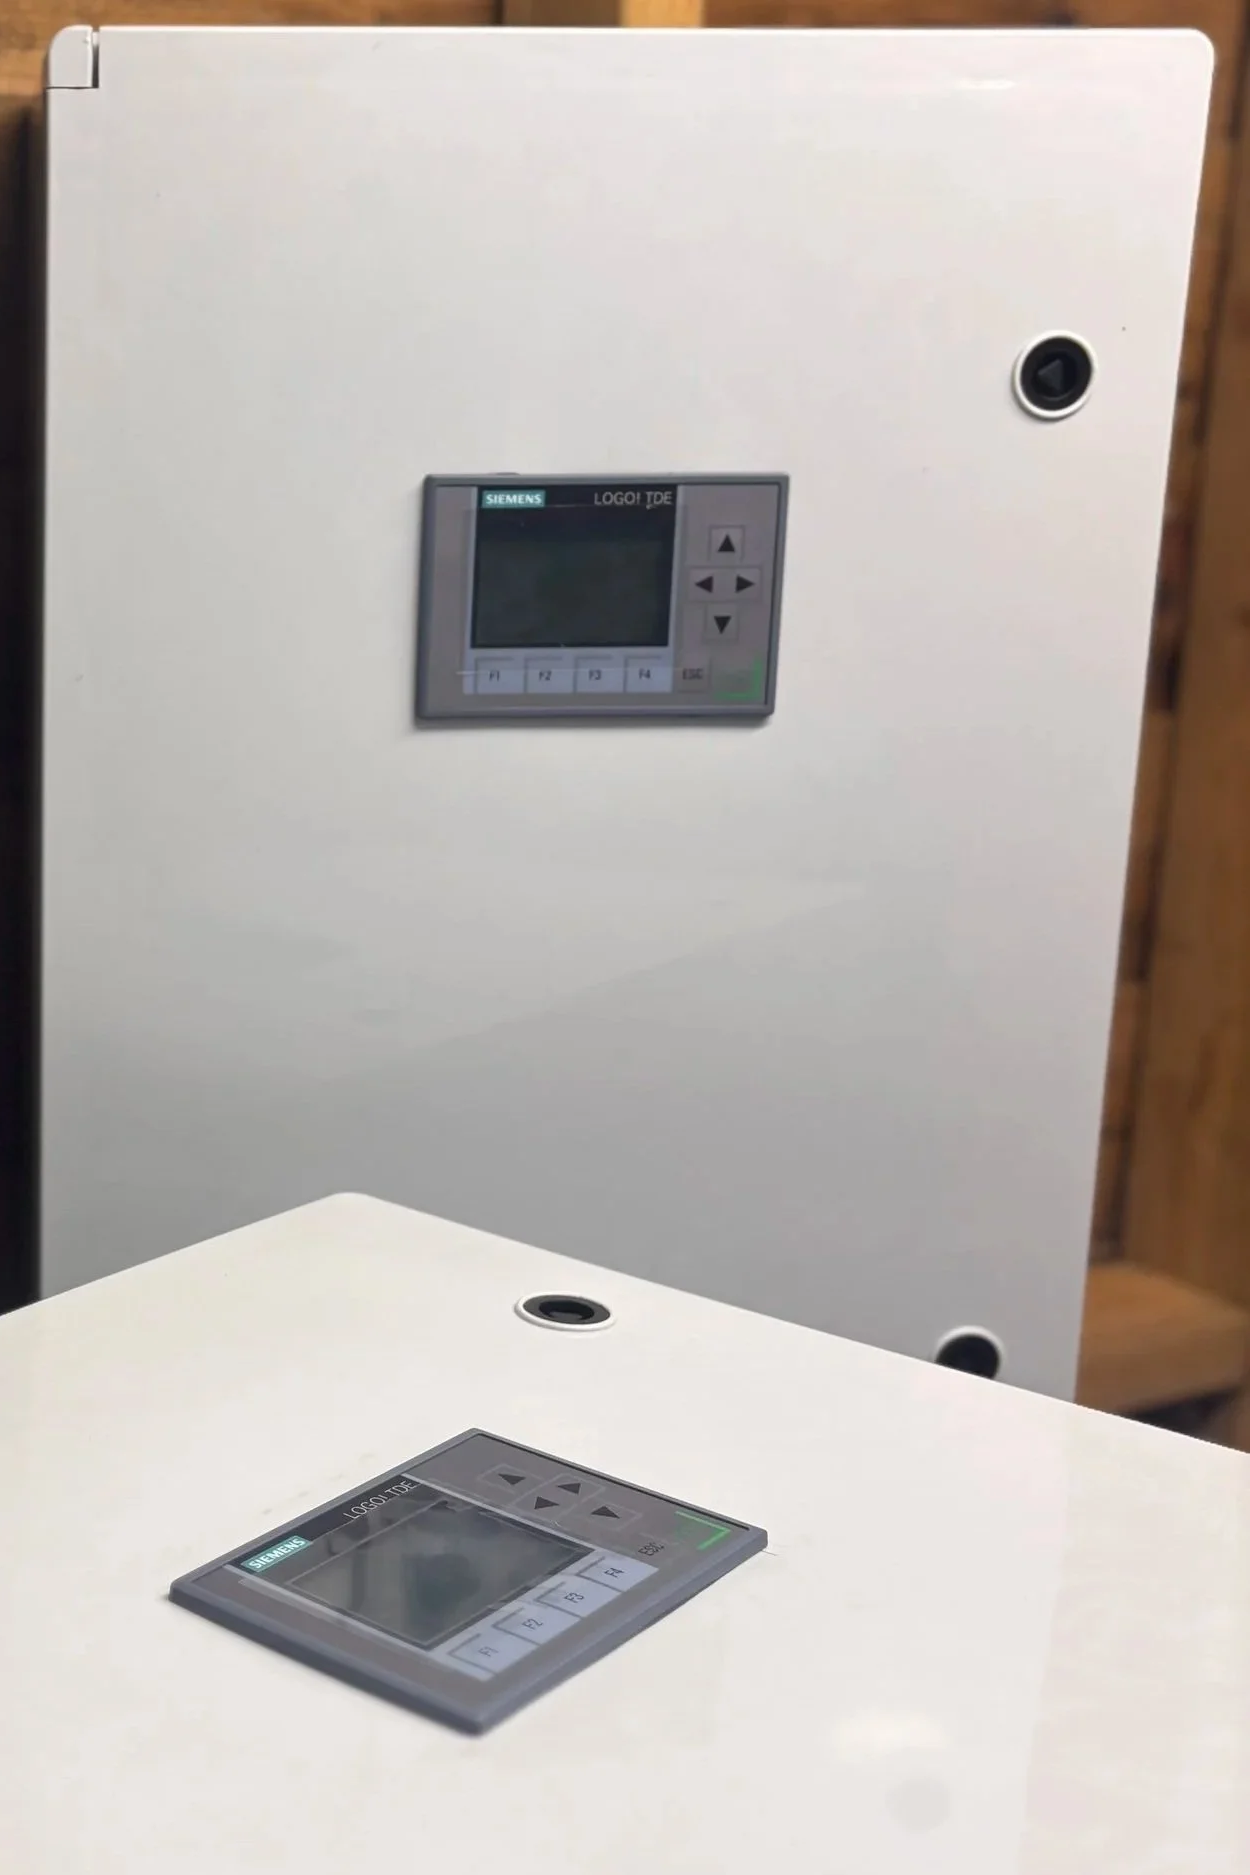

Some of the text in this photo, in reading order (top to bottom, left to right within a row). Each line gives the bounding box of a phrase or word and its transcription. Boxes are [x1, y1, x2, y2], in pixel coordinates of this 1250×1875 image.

[485, 493, 542, 505] SIEMENS
[594, 491, 673, 506] LOGO! TDE
[489, 669, 651, 681] F1 F2 F3 F4
[682, 668, 703, 680] ESC
[343, 1480, 416, 1520] LOGO! TDE
[249, 1537, 305, 1569] SIEMENS
[478, 1567, 625, 1657] F1 F2 F3 F4
